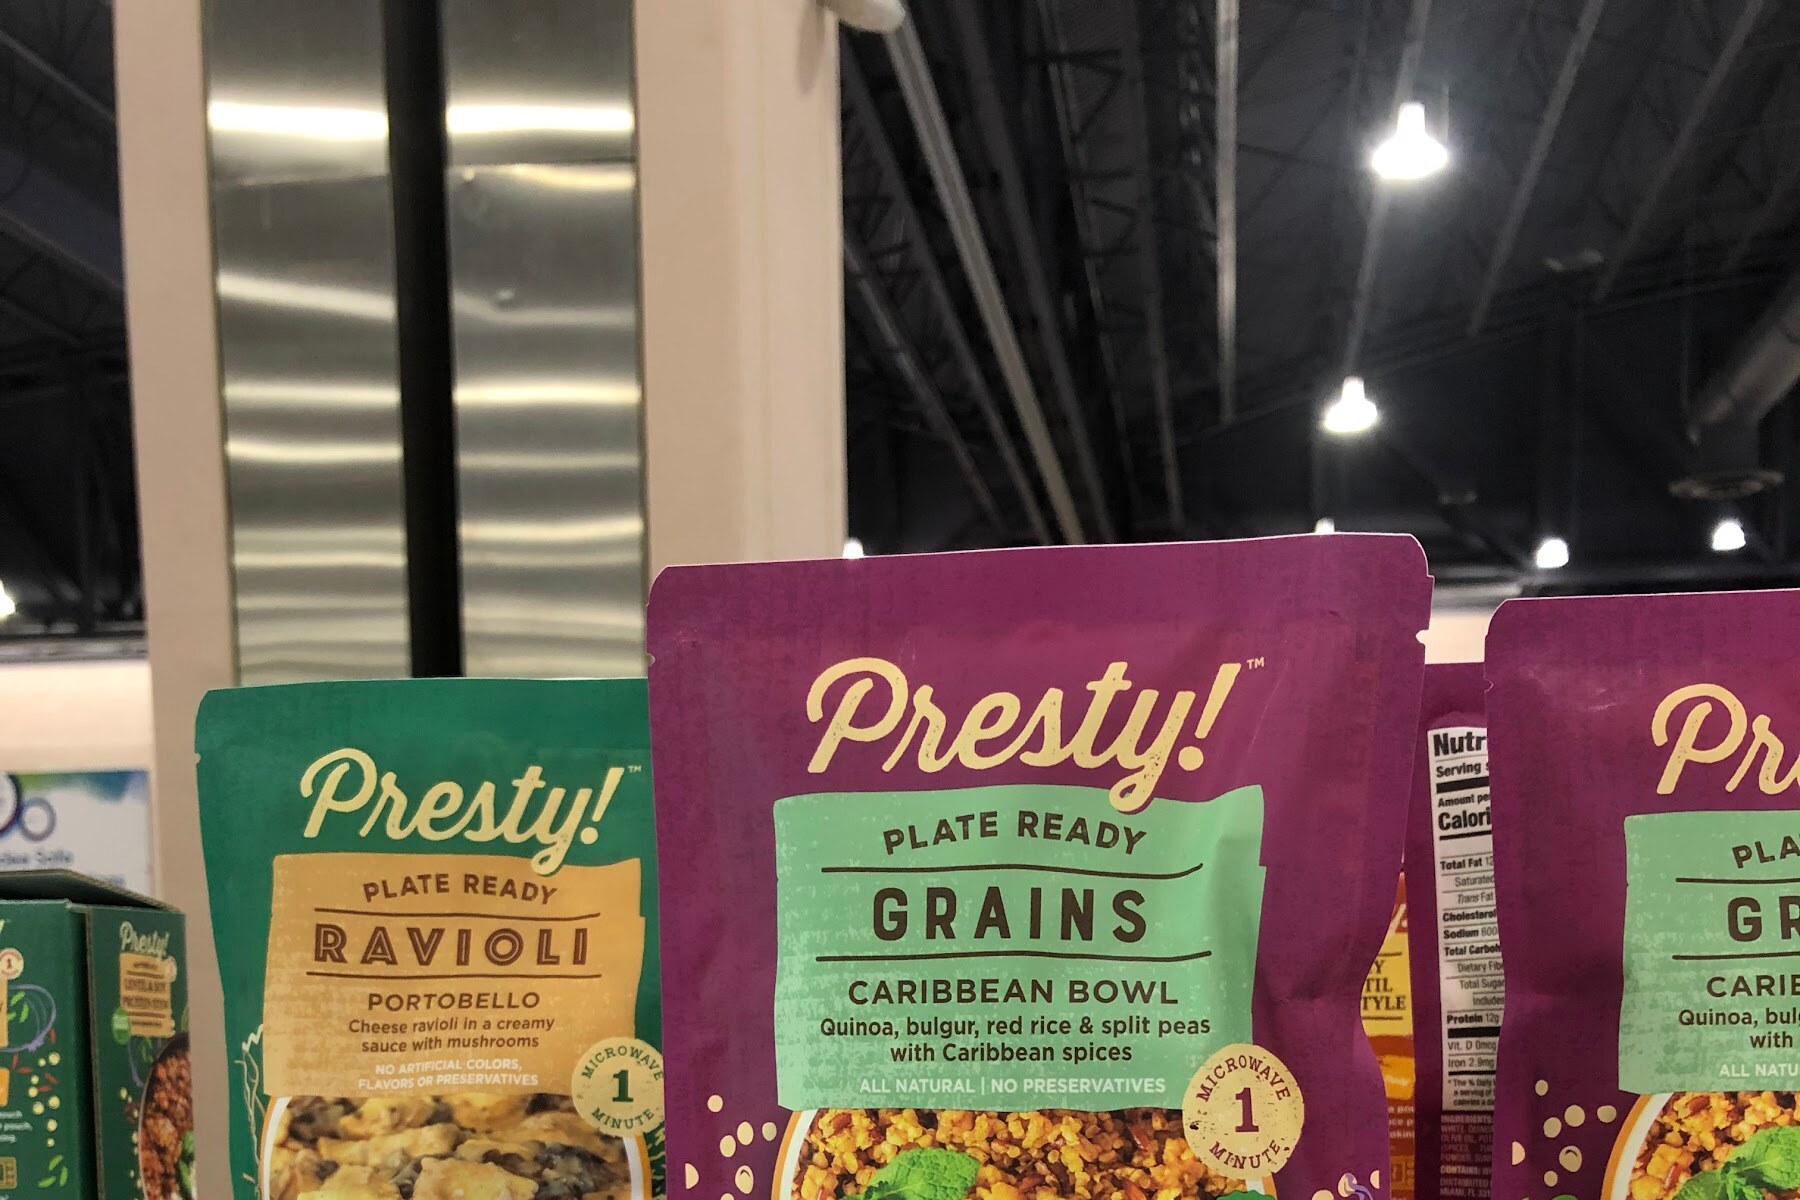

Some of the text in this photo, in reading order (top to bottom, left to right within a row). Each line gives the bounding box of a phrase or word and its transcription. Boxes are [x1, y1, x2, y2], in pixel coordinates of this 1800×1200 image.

[805, 656, 1242, 814] Presty!
[1651, 683, 1800, 795] Pr
[1436, 762, 1481, 778] Serving
[301, 748, 624, 875] Presty!
[1438, 794, 1475, 808] Amount
[882, 810, 1147, 855] PLATE READY
[1440, 857, 1483, 871] Total Fat
[363, 873, 558, 905] PLATE READY
[1481, 891, 1494, 902] Fat
[872, 886, 1147, 943] GRAINS
[313, 923, 589, 966] RAVIOLI
[1443, 928, 1479, 940] Sodium
[1444, 946, 1467, 957] Total
[368, 991, 540, 1012] PORTOBELLO
[847, 978, 1179, 1005] CARIBBEAN BOWL
[348, 1017, 555, 1035] Cheese ravioli in a creamy
[819, 1015, 1211, 1040] Quinoa, bulgur, red rice & split peas
[1447, 1013, 1483, 1026] Protein
[1678, 1009, 1758, 1028] Quinoa,
[362, 1034, 540, 1053] sauce with mushrooms
[1749, 1031, 1794, 1049] with
[581, 1045, 664, 1081] MICROWAVE
[890, 1042, 1132, 1067] with Caribbean spices
[376, 1059, 523, 1075] NO ARTIFICIAL COLORS,
[1719, 1063, 1750, 1078] ALL
[358, 1073, 539, 1091] FLAVORS OR PRESERVATIVES
[612, 1069, 634, 1103] 1
[859, 1077, 1167, 1094] ALL NATURAL NO PRESERVATIVES
[1196, 1054, 1291, 1103] MICROWAVE
[591, 1107, 655, 1129] MINUTE
[1234, 1087, 1259, 1133] 1
[1209, 1139, 1281, 1170] MINUTE
